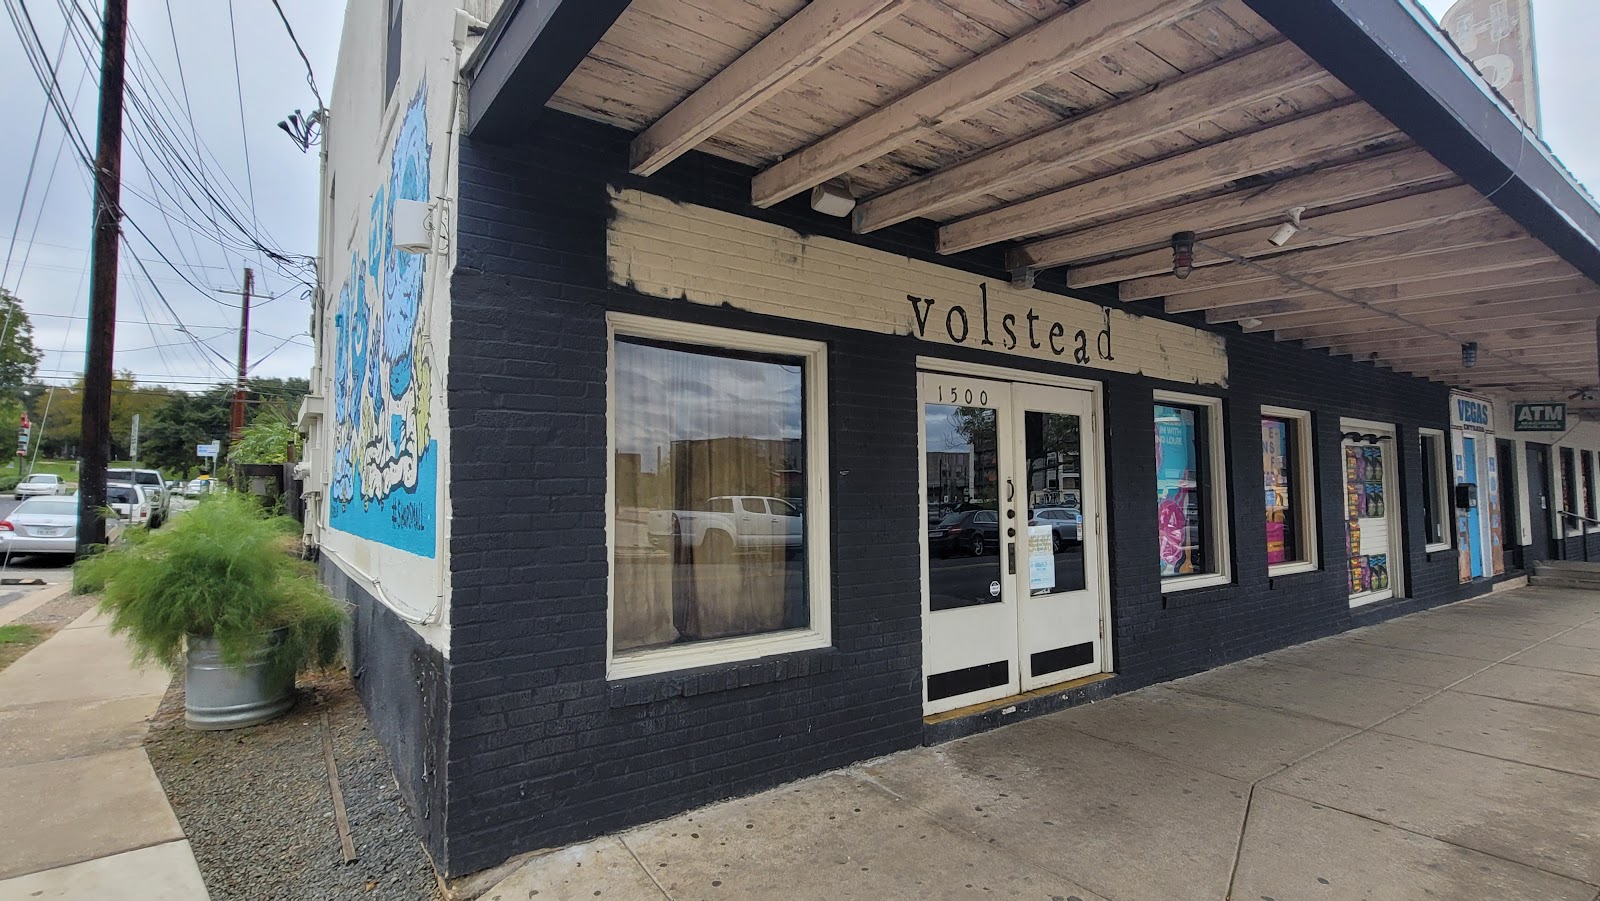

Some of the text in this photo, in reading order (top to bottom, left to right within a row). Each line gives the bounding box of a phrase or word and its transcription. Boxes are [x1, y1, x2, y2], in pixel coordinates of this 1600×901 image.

[906, 281, 1115, 365] volstead
[937, 384, 988, 406] 1500
[1457, 398, 1488, 425] VEGAS
[1518, 406, 1563, 421] ATM
[1167, 427, 1182, 436] WITH
